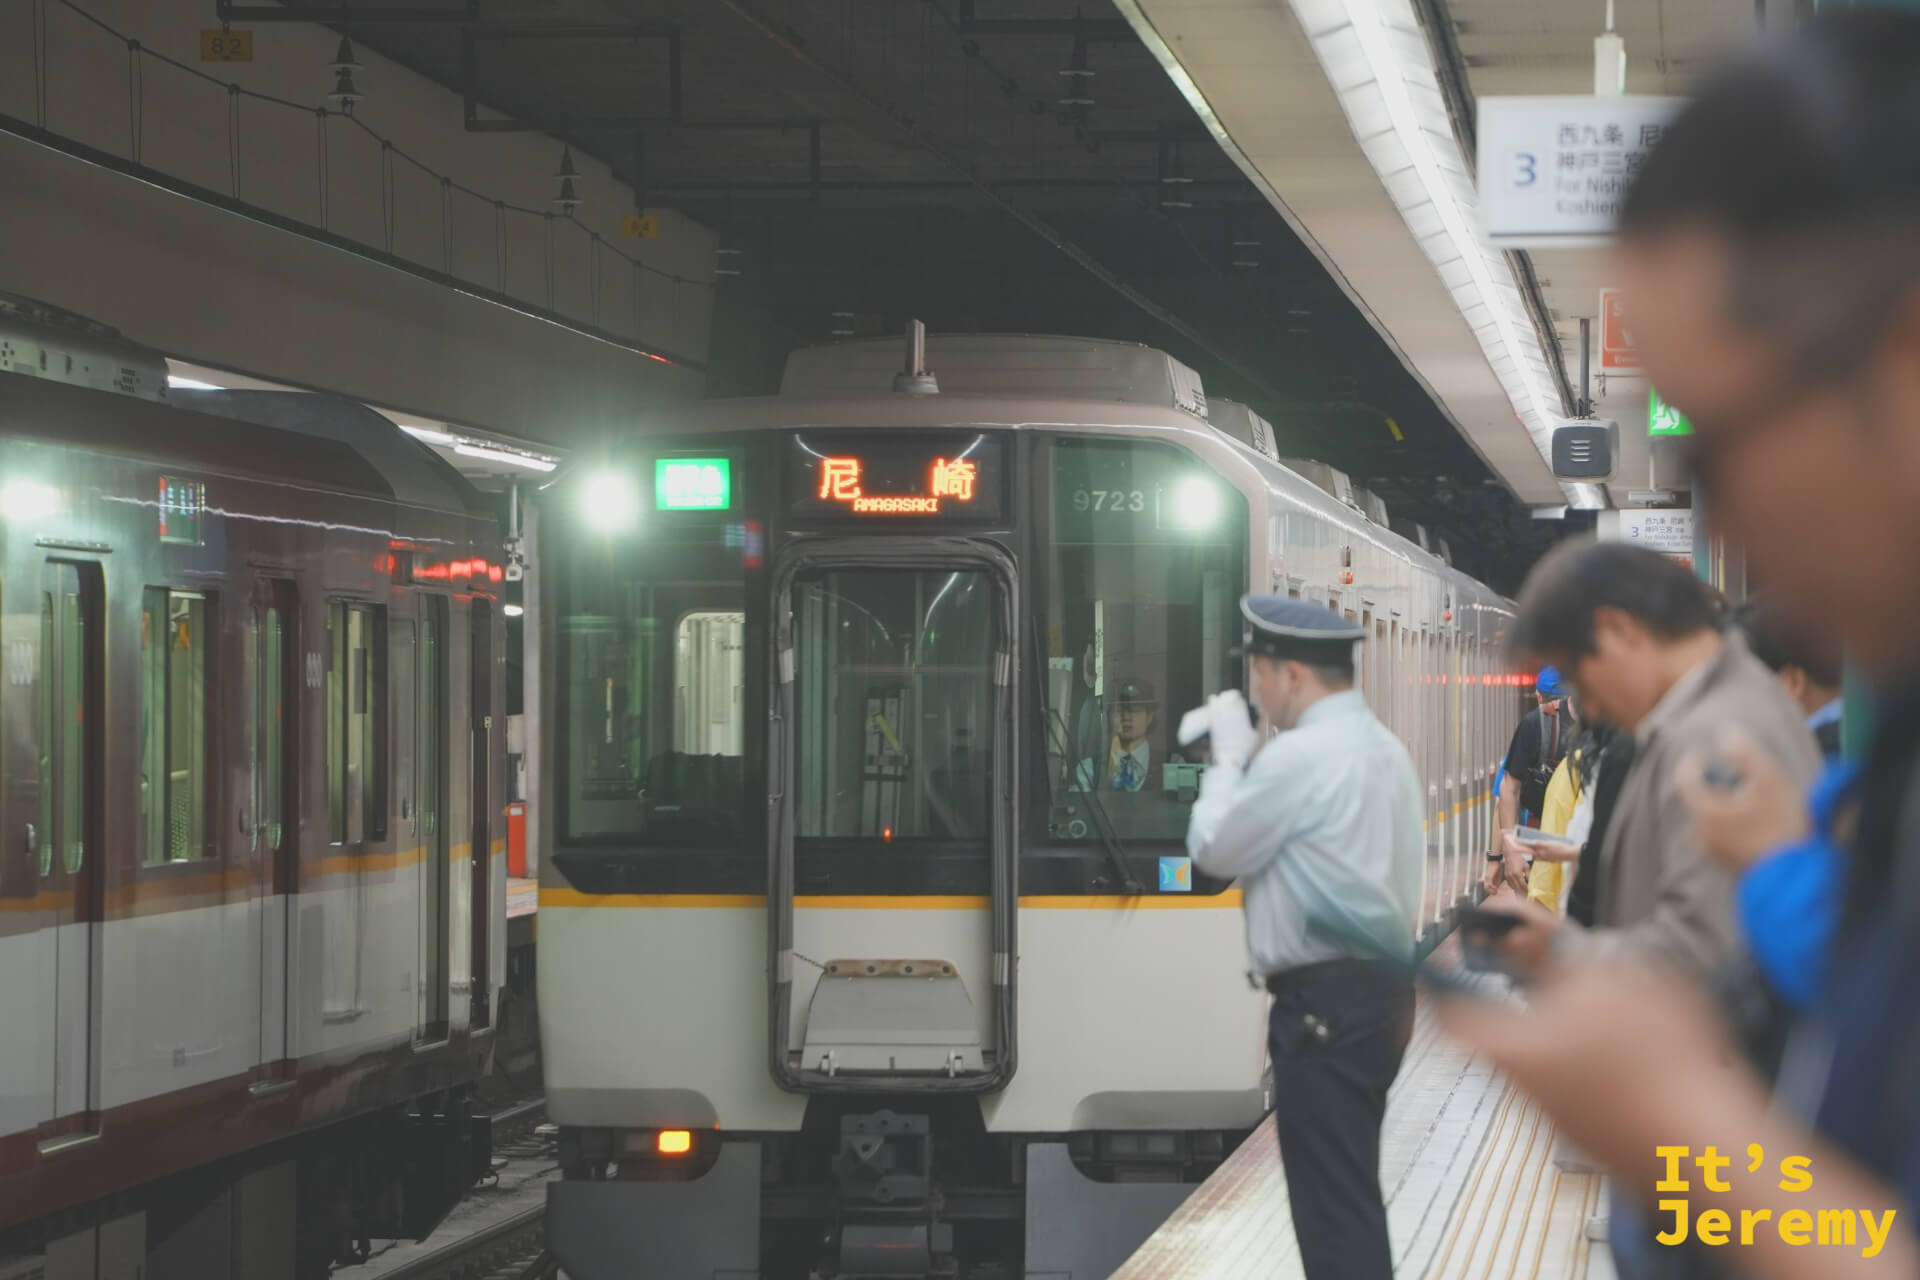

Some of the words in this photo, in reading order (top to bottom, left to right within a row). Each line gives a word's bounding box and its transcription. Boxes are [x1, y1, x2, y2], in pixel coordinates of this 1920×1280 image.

[1558, 122, 1625, 147] 西九条
[1640, 122, 1668, 147] 尼
[1513, 152, 1537, 188] 3
[853, 497, 939, 513] AMAGASAKI
[1073, 489, 1145, 512] 9723
[1631, 526, 1640, 538] 3
